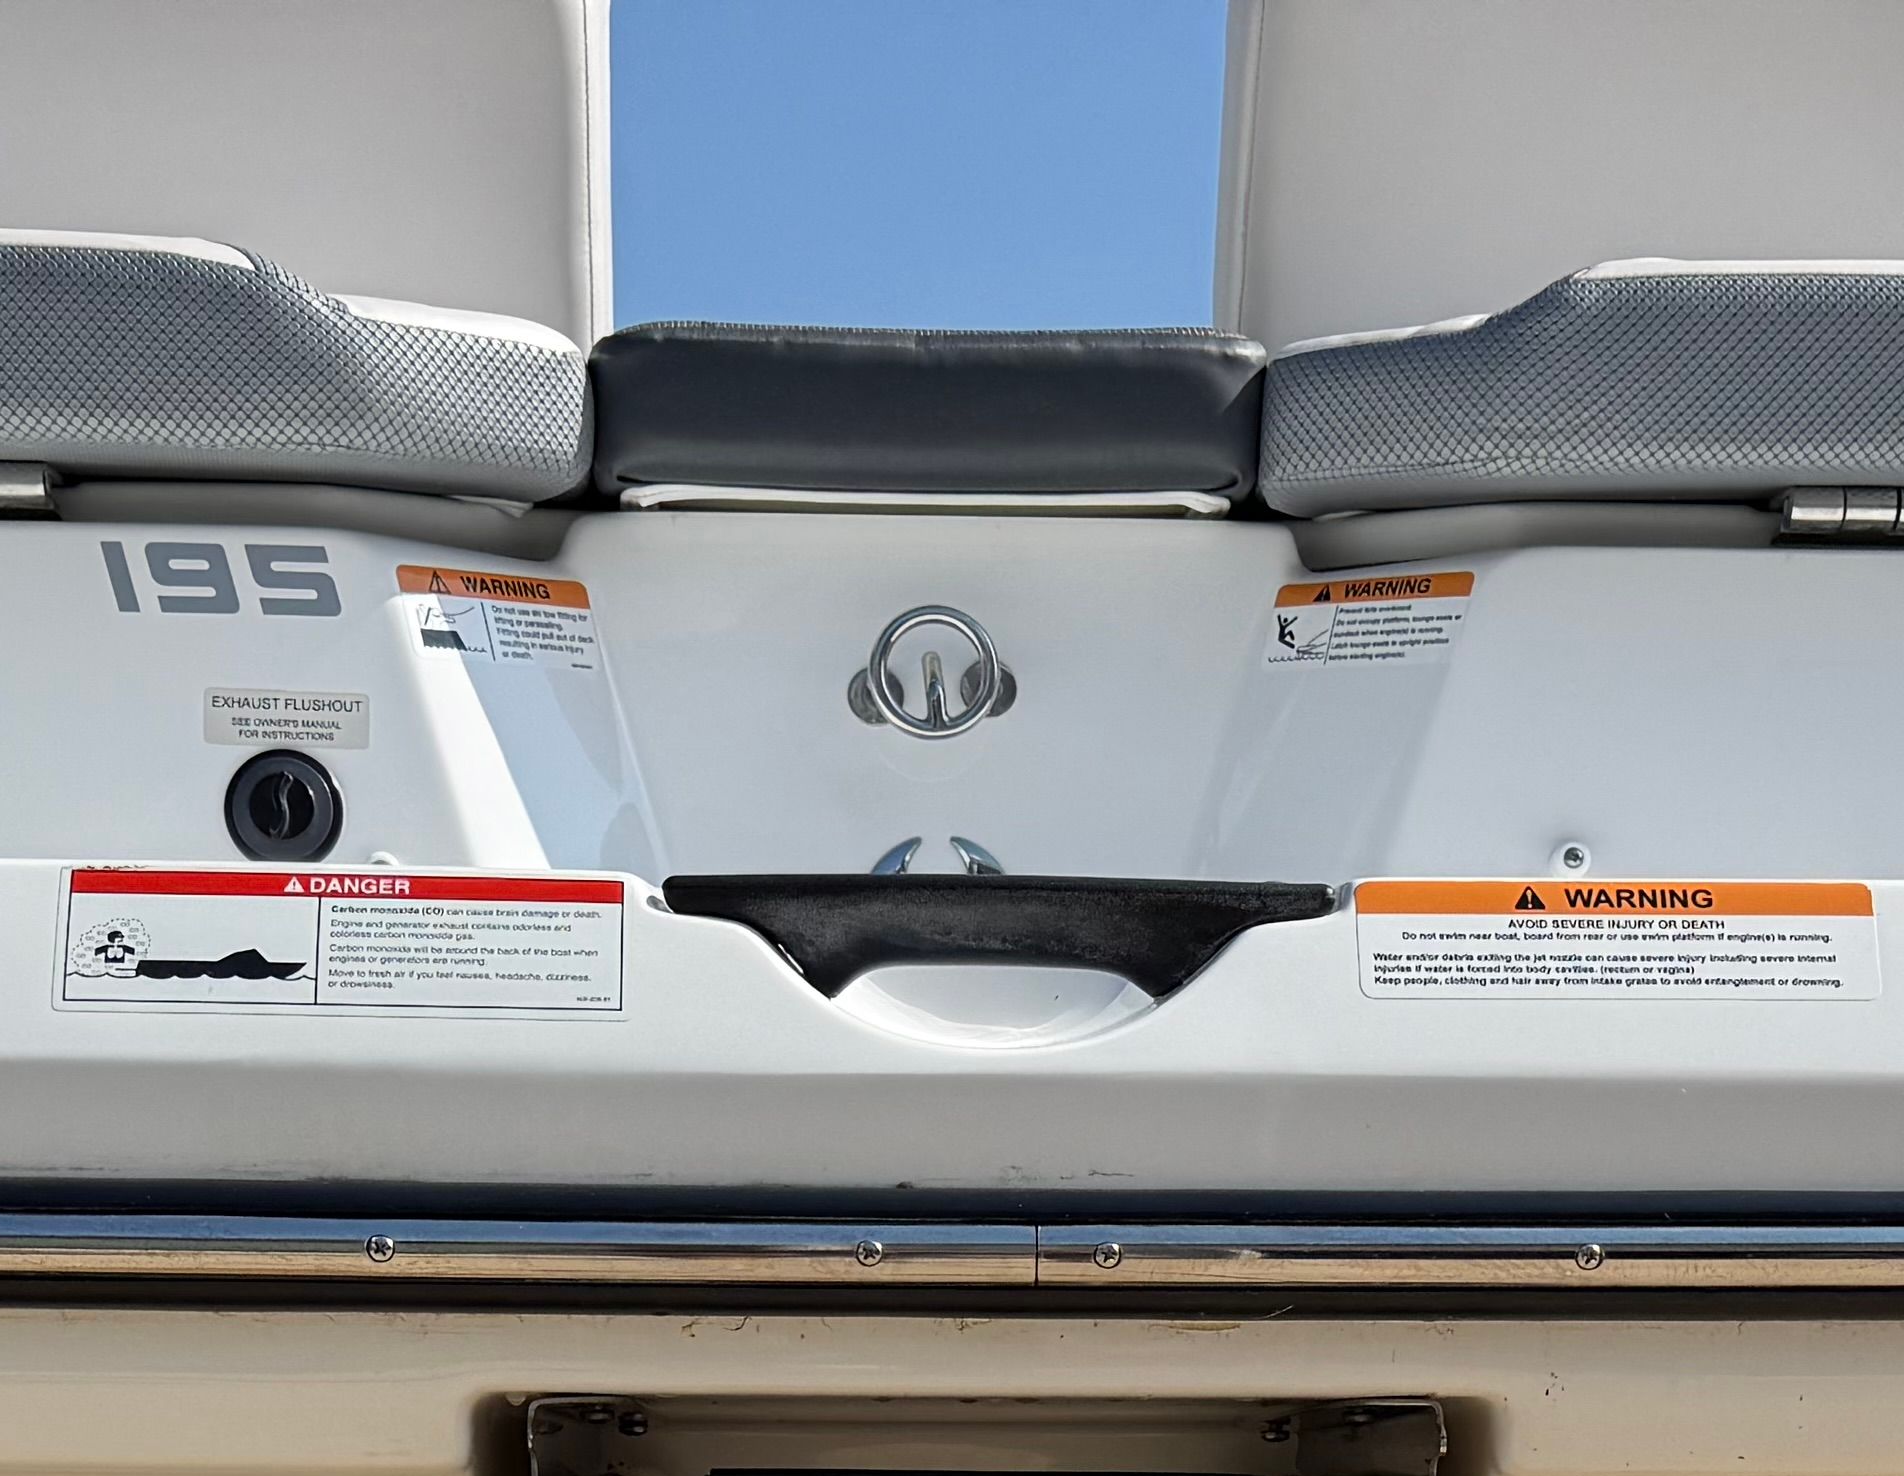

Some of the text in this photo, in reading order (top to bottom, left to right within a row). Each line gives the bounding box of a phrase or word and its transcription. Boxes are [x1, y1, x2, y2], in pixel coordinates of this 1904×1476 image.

[100, 541, 342, 617] 195
[460, 576, 551, 600] WARNING
[1345, 578, 1432, 599] WARNING
[212, 695, 363, 713] EXHAUST FLUSHOUT
[232, 717, 342, 729] SEE OWNER'S MANUAL
[239, 729, 334, 741] FOR INSTRUCTIONS
[310, 877, 410, 895] DANGER
[1564, 888, 1713, 909] WARNING
[1508, 919, 1725, 929] AVOID SEVERE INJURY OR DEATH
[1402, 932, 1416, 940] Do
[1420, 932, 1436, 940] not
[1439, 932, 1466, 940] swim
[1495, 932, 1520, 941] boat,
[1524, 932, 1553, 940] board
[1557, 932, 1580, 940] from
[1642, 933, 1669, 941] swim
[1672, 932, 1714, 942] platform
[1718, 933, 1725, 941] if
[1727, 933, 1775, 943] engine(s)
[1790, 934, 1832, 943] running.
[1373, 953, 1402, 961] Water
[1406, 953, 1438, 961] and/or
[1442, 953, 1473, 961] debris
[1477, 953, 1511, 963] exiting
[1533, 954, 1546, 963] jet
[1677, 954, 1706, 964] injury
[1710, 954, 1757, 964] including
[1415, 965, 1421, 973] if
[1456, 965, 1464, 973] is
[1467, 965, 1500, 973] forced
[1503, 965, 1522, 973] into
[1526, 965, 1551, 974] body
[1600, 965, 1640, 974] (rectum
[1657, 966, 1695, 975] vagina)
[1374, 977, 1401, 985] Keep
[1404, 977, 1442, 985] people,
[1444, 977, 1487, 986] clothing
[1490, 977, 1509, 985] and
[1512, 977, 1532, 985] hair
[1535, 978, 1560, 986] away
[1564, 977, 1588, 985] from
[1591, 977, 1622, 985] intake
[1625, 978, 1658, 987] grates
[1660, 978, 1671, 986] to
[1705, 978, 1775, 987] entanglement
[1792, 978, 1843, 988] drowning.
